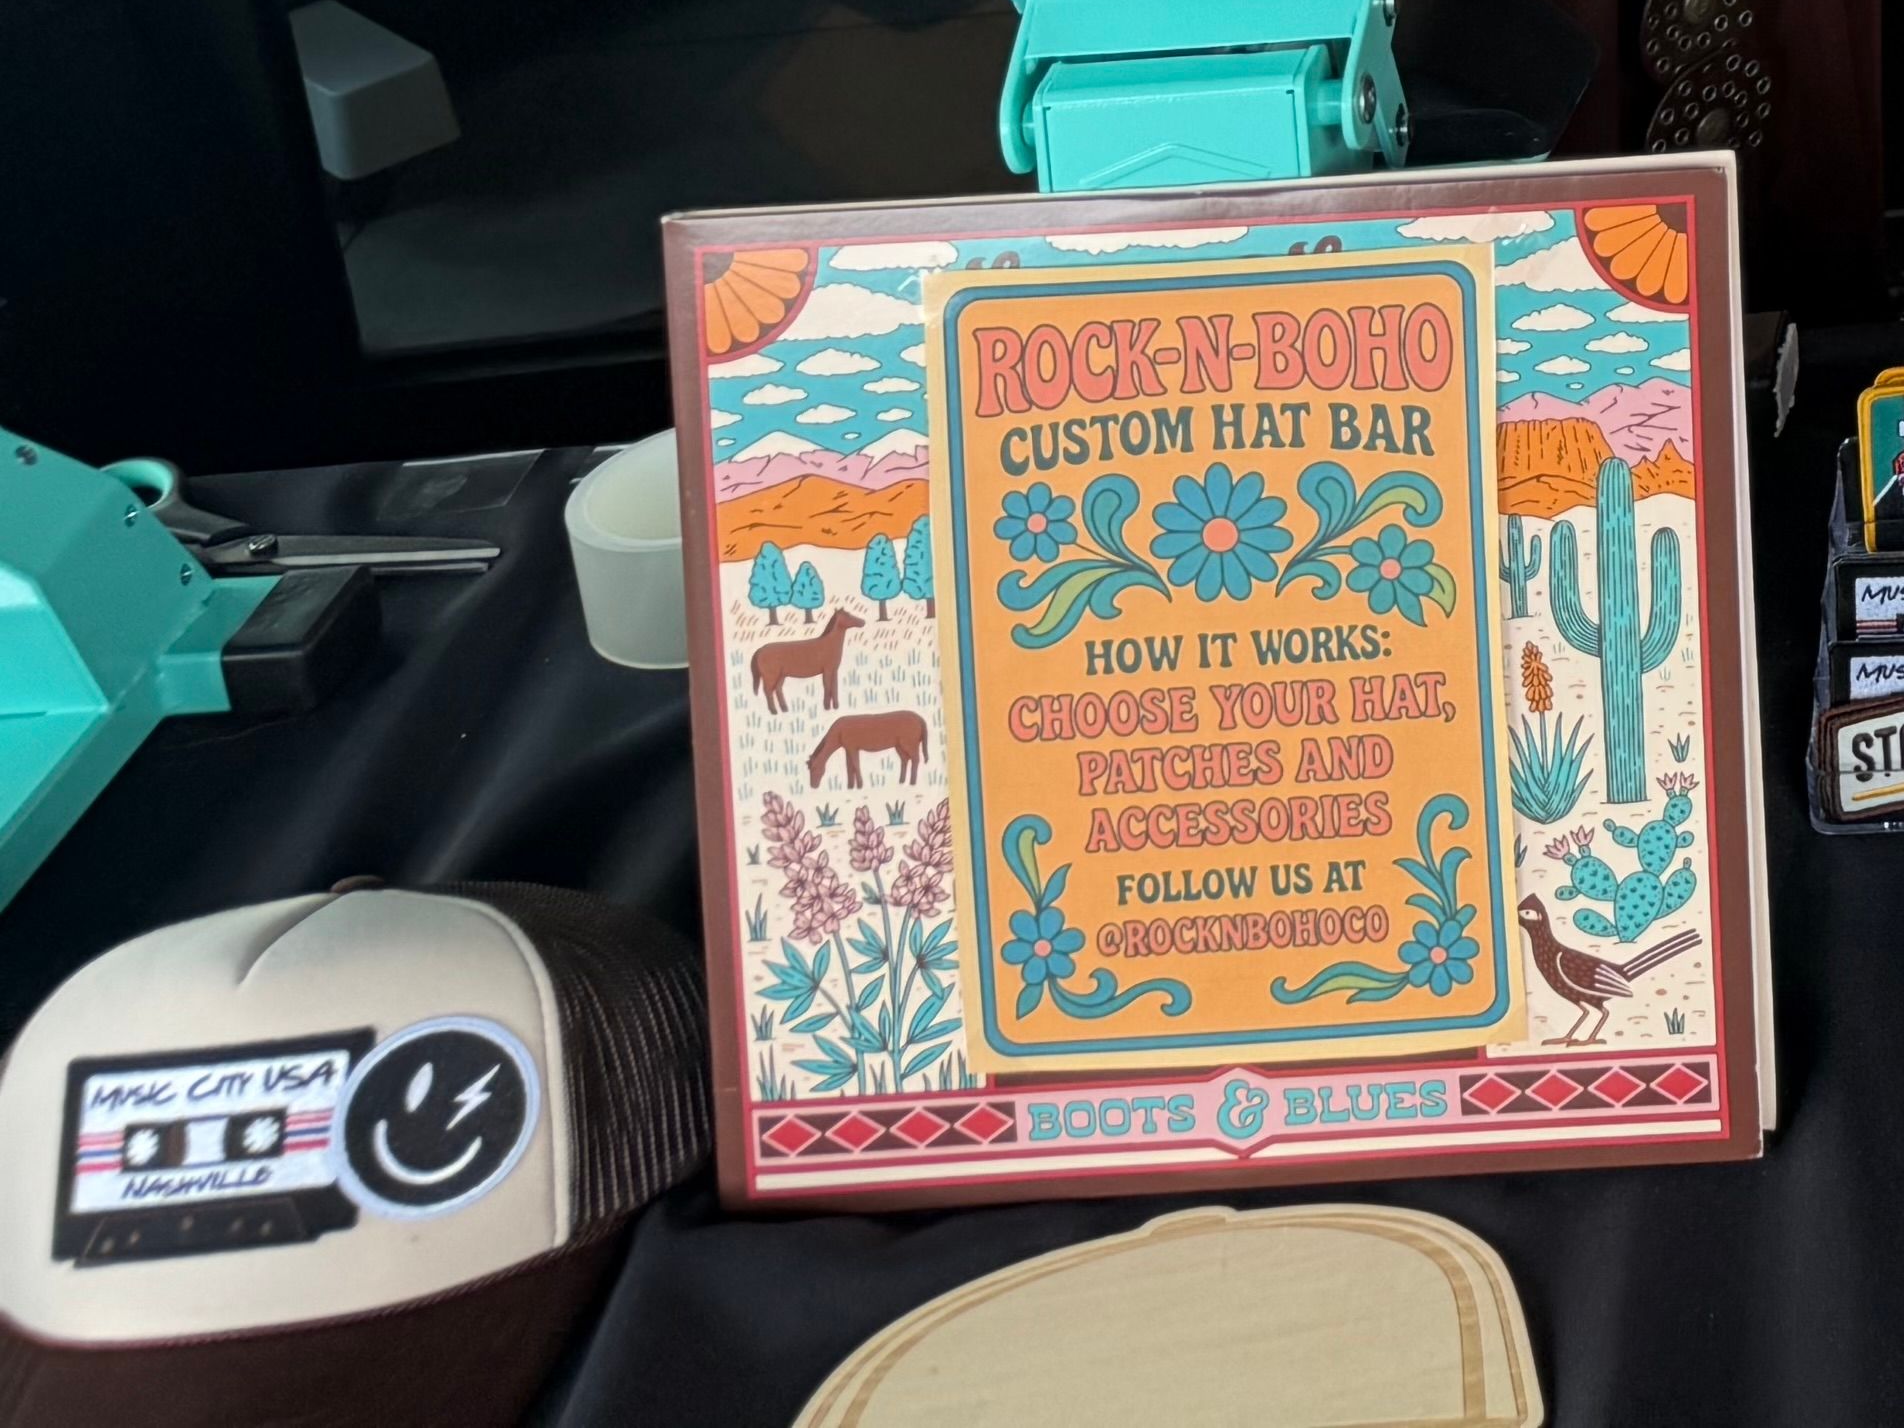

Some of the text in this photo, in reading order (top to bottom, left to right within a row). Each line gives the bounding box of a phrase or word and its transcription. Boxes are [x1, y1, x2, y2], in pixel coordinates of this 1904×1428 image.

[973, 301, 1454, 418] ROCK-N-BOHO
[1000, 401, 1435, 476] CUSTOM HAT BAR
[1085, 624, 1393, 676] HOW IT WORKS:
[1008, 671, 1456, 742] CHOOSE YOUR HAT,
[1076, 734, 1394, 796] PATCHES AND
[1085, 791, 1393, 853] ACCESSORIES
[1116, 860, 1367, 906] FOLLOW US AT
[1097, 904, 1390, 958] @ROCKNBOHOCO
[90, 1059, 338, 1112] MUSIC CITY USA
[1027, 1078, 1448, 1142] BOOTS & BLUES
[120, 1165, 274, 1200] NASHVILLE
